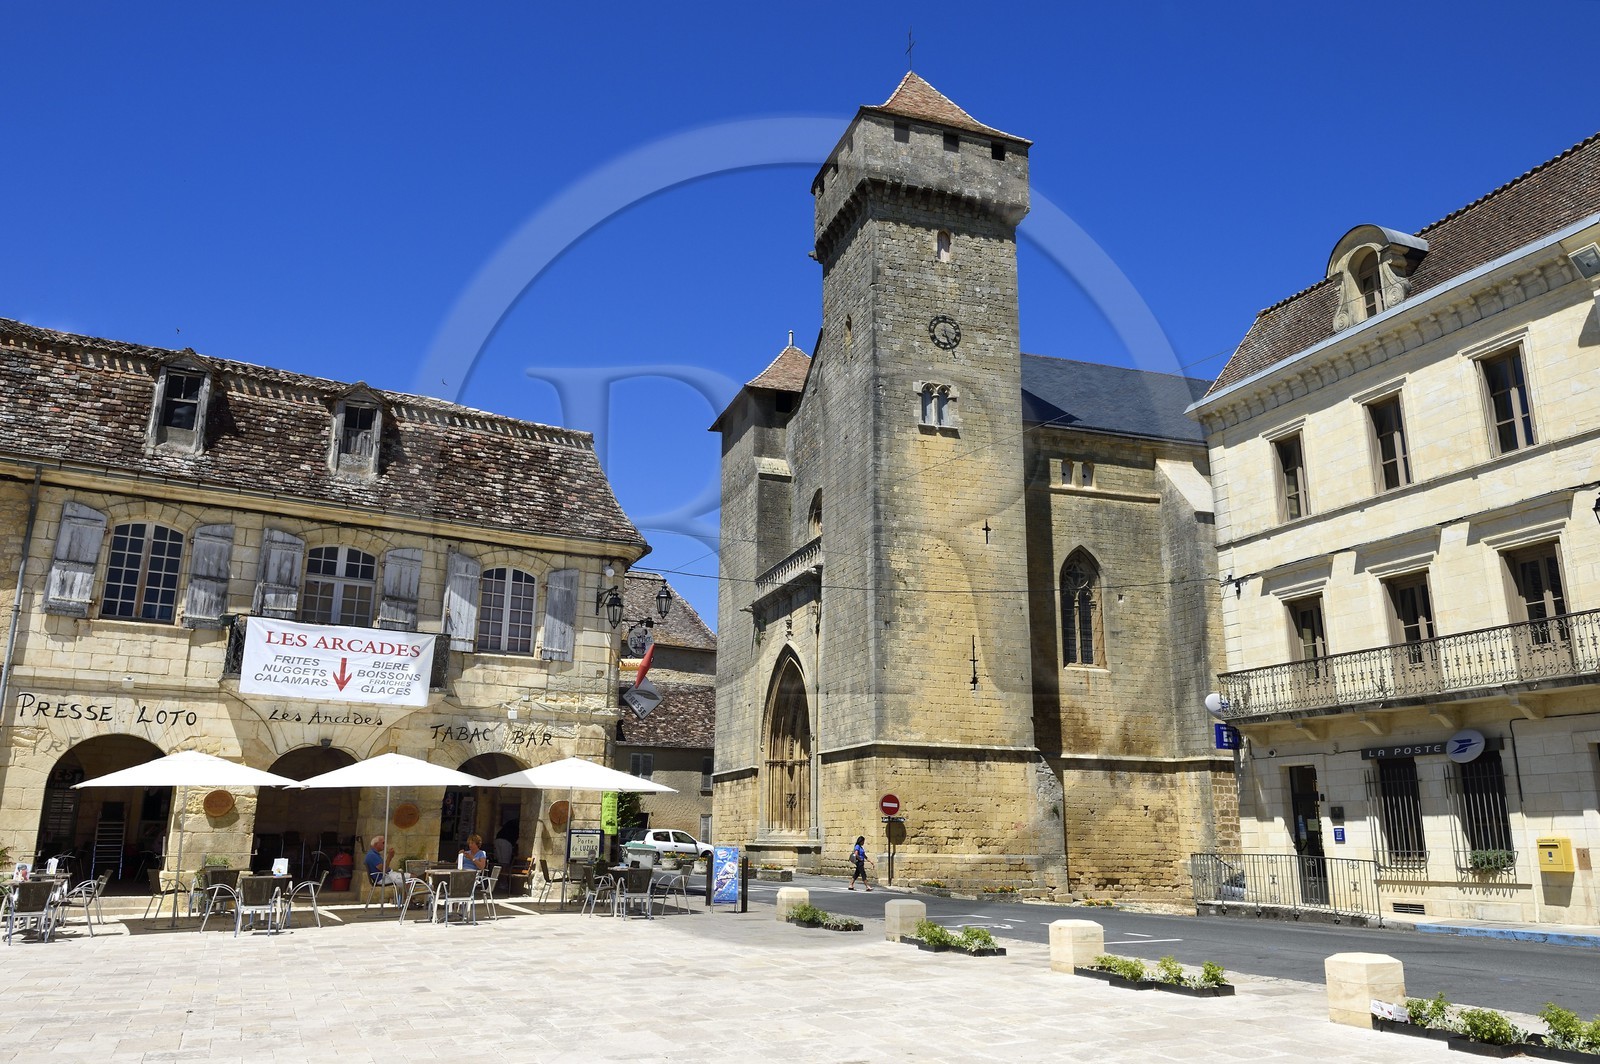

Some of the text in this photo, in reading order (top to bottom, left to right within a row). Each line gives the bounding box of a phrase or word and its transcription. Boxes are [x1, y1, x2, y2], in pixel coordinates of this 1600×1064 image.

[265, 630, 421, 658] LES ARCADES
[274, 654, 320, 666] FRITES
[372, 661, 410, 671] BIERE
[263, 664, 327, 677] NUGGETS
[356, 669, 421, 682] BOISSONS
[254, 673, 329, 687] CALAMARS
[369, 678, 412, 687] FRAICHES
[360, 684, 412, 696] GLACES
[16, 693, 197, 726] PRESSE LOTO
[626, 692, 647, 716] PRESSE
[268, 709, 383, 726] Les Arcades
[430, 723, 553, 748] TABAC BAR
[1368, 744, 1442, 758] LA POSTE
